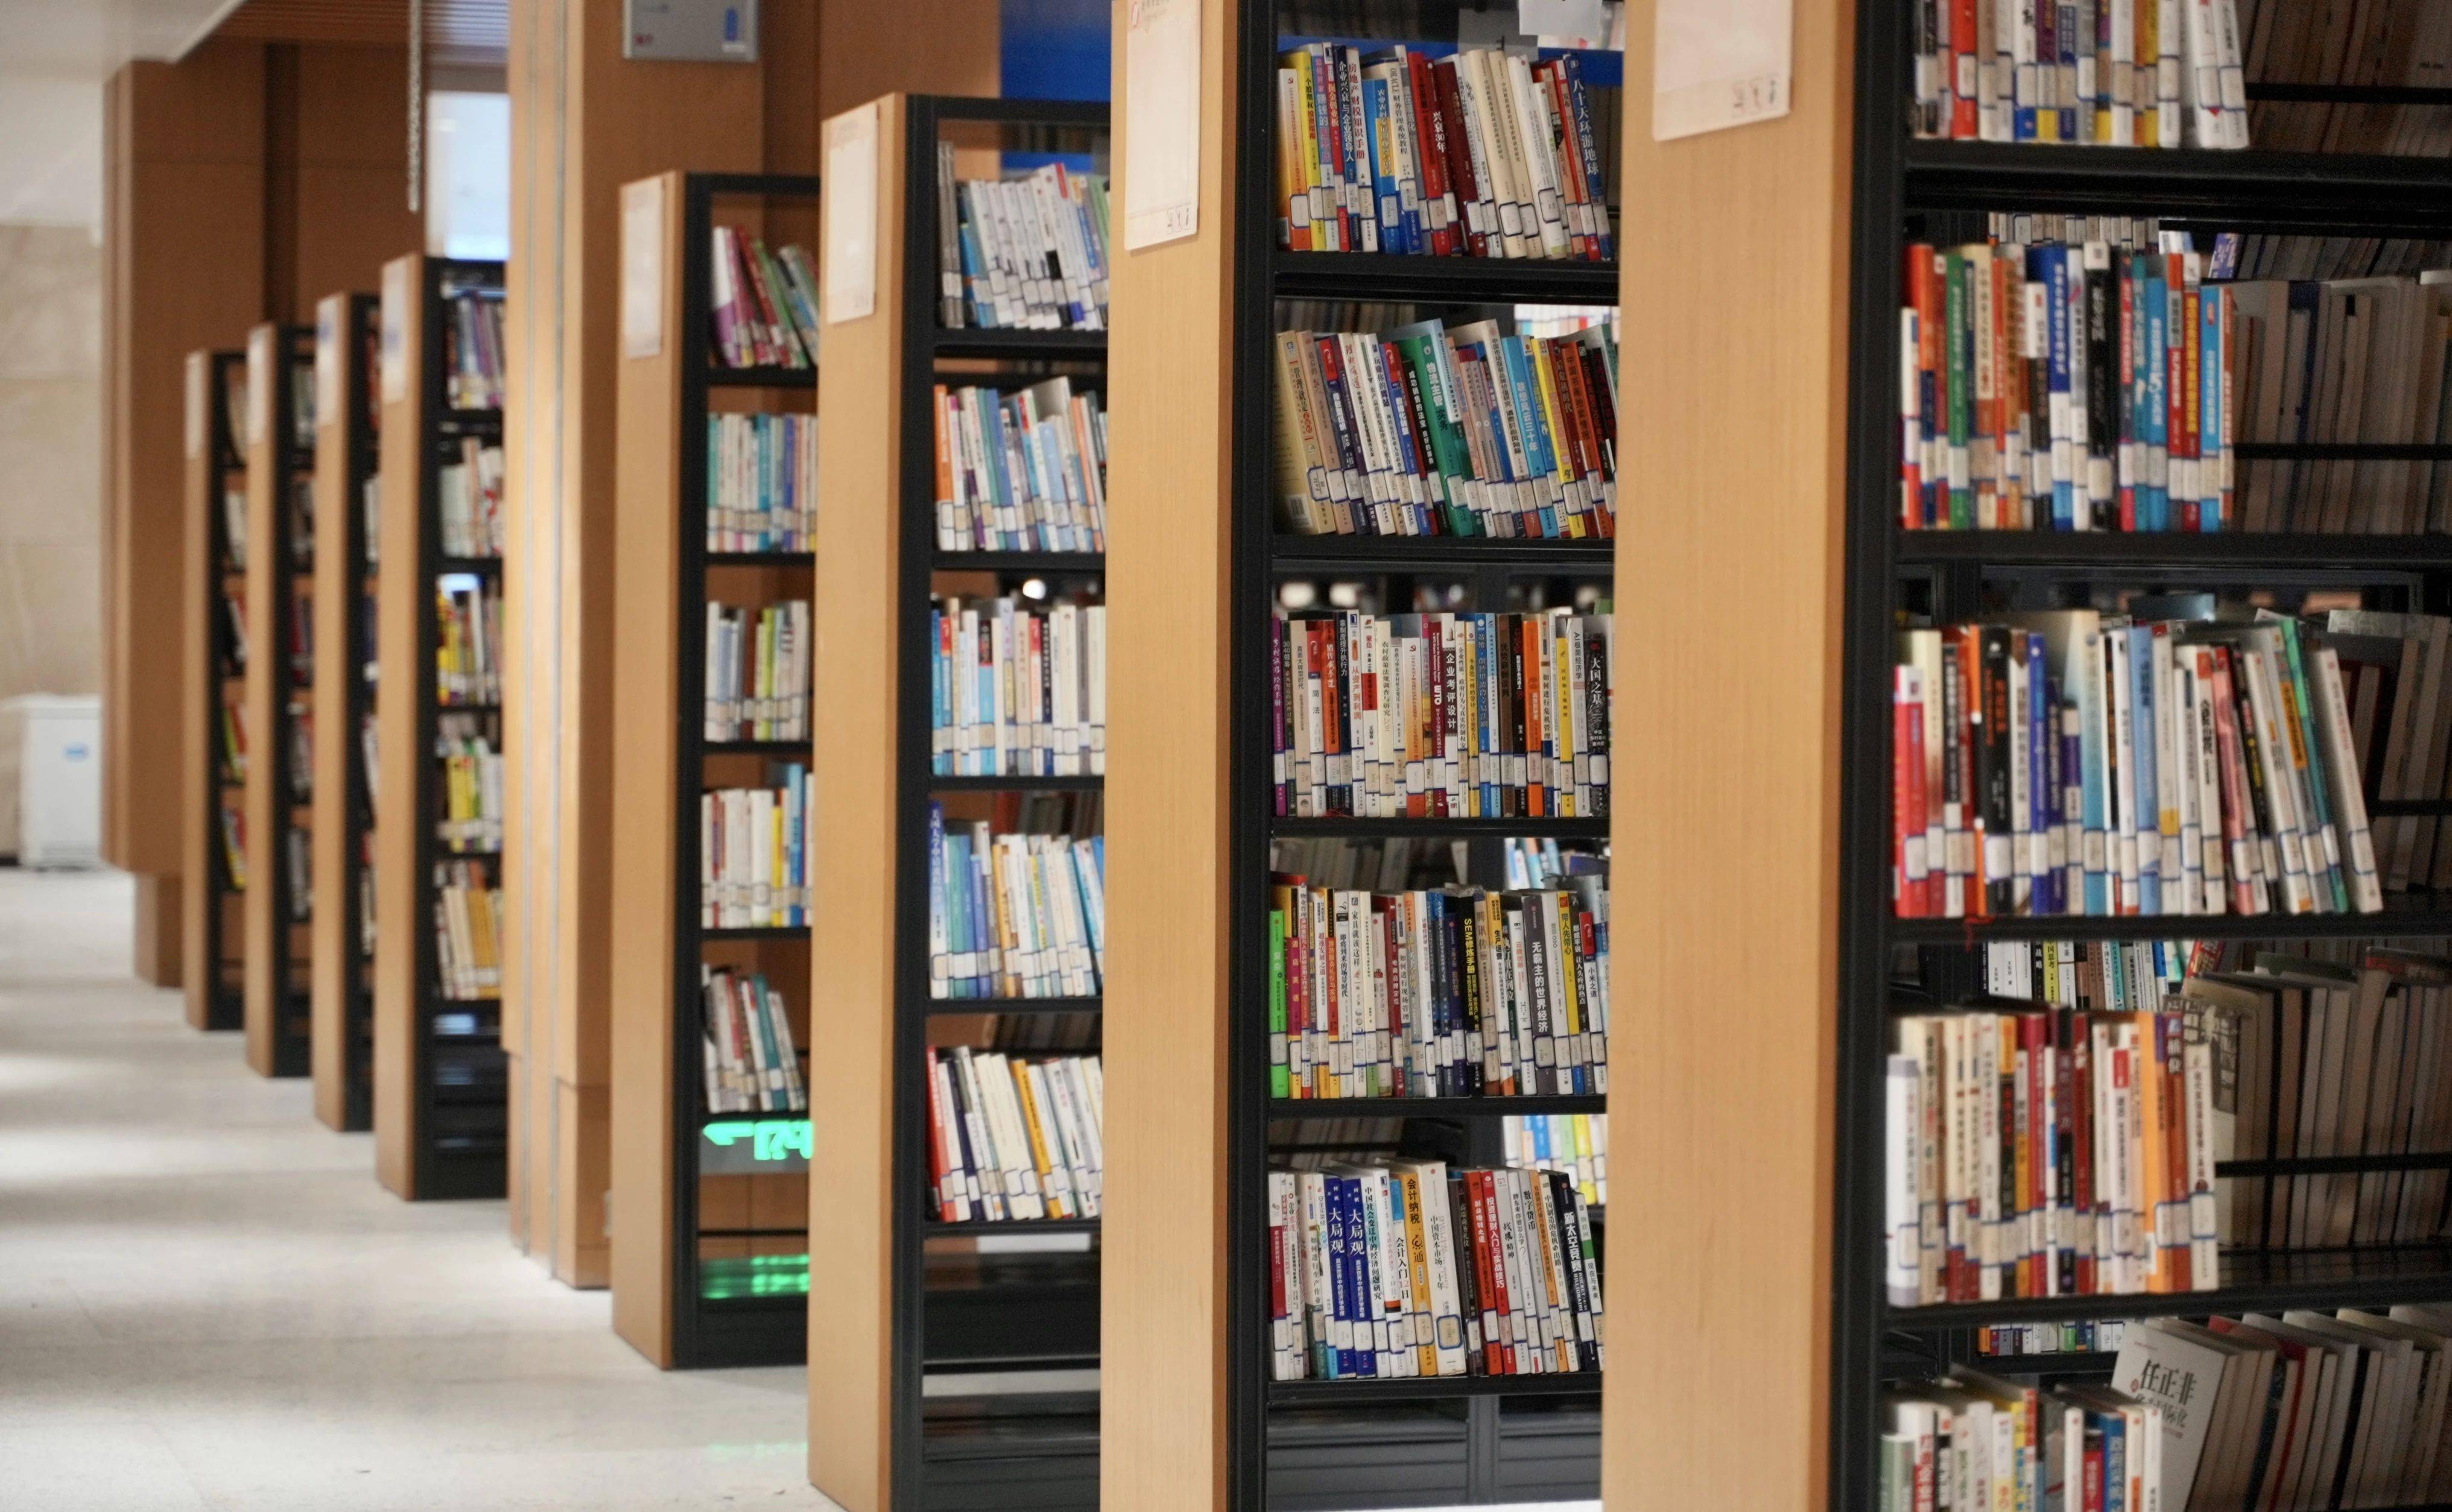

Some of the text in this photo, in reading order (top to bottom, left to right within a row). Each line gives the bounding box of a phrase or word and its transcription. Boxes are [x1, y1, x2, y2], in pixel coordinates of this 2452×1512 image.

[1338, 62, 1354, 162] 企业兴衰与企业领导人
[1349, 63, 1364, 159] 房地产财税知识手册
[1393, 95, 1407, 154] 财务管理系统教程
[1433, 112, 1446, 153] 兴衰30年
[1573, 79, 1598, 175] 八十天环游地球
[1557, 360, 1573, 413] 后危机时代
[1382, 641, 1390, 716] 农村政策法规调查与研究
[1574, 632, 1582, 680] AI极简经济学
[1590, 657, 1602, 705] 大国之基
[1352, 666, 1361, 720] 从资产到利润
[1446, 653, 1456, 729] 企业考评设计
[1561, 913, 1572, 955] 带人先带心
[1400, 955, 1409, 1020] 如何进行现场管理
[1532, 941, 1548, 1033] 无霸主的世界经济
[1328, 1207, 1345, 1254] 大局观
[1349, 1209, 1365, 1256] 大局观
[1523, 1190, 1536, 1230] 数字货币
[1310, 1237, 1322, 1304] 如何进行生产作业
[1365, 1187, 1381, 1300] 中国社会变迁中的经济问题研究
[1395, 1237, 1409, 1299] 会计入门12日
[1486, 1197, 1504, 1288] 投资理财入门与实战技巧
[1563, 1212, 1582, 1273] 新太空竞赛
[2140, 1359, 2196, 1405] 任正非
